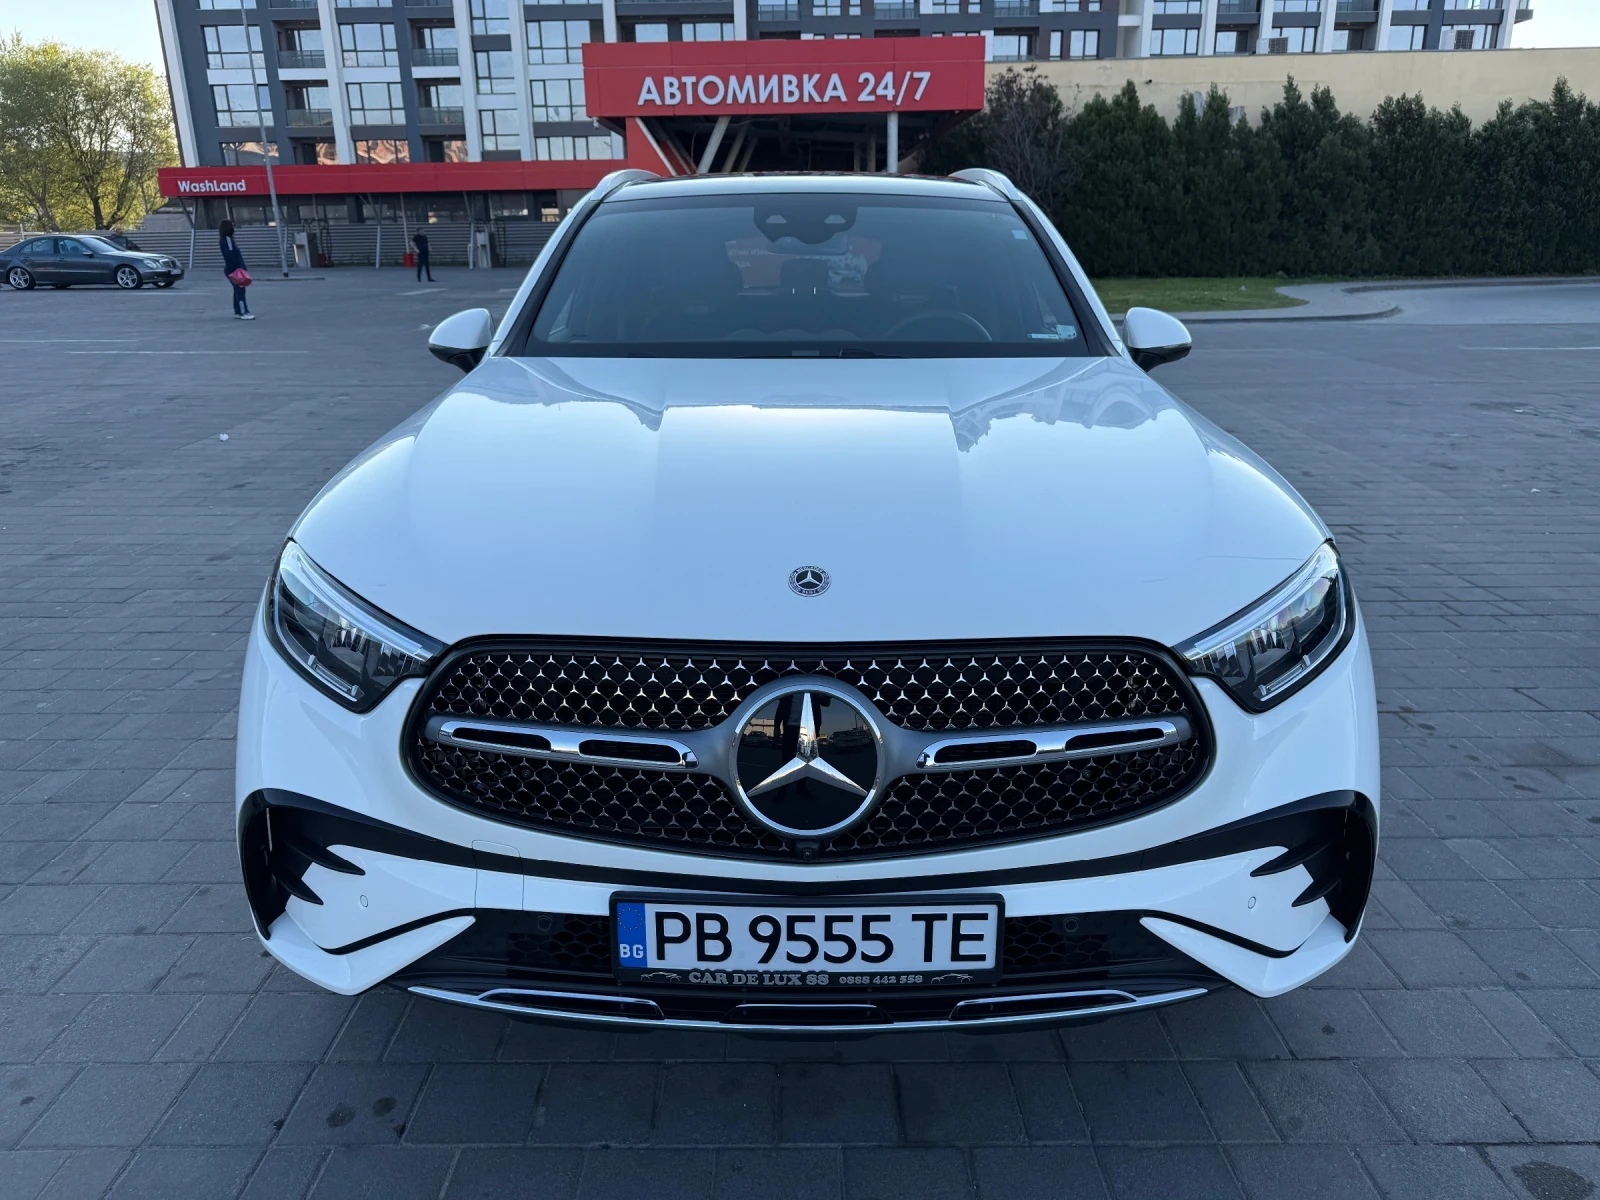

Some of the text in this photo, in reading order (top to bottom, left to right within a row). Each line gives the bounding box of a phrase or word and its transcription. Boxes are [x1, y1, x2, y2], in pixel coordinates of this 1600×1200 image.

[637, 71, 932, 106] АВТОМИВКА 24/7
[178, 179, 247, 193] WashLand
[655, 911, 989, 964] PB 9555 TE
[619, 943, 644, 959] BG
[688, 971, 728, 984] CAR
[732, 973, 759, 985] DE
[763, 974, 802, 985] LUX
[839, 976, 870, 984] 0888
[872, 976, 896, 984] 442
